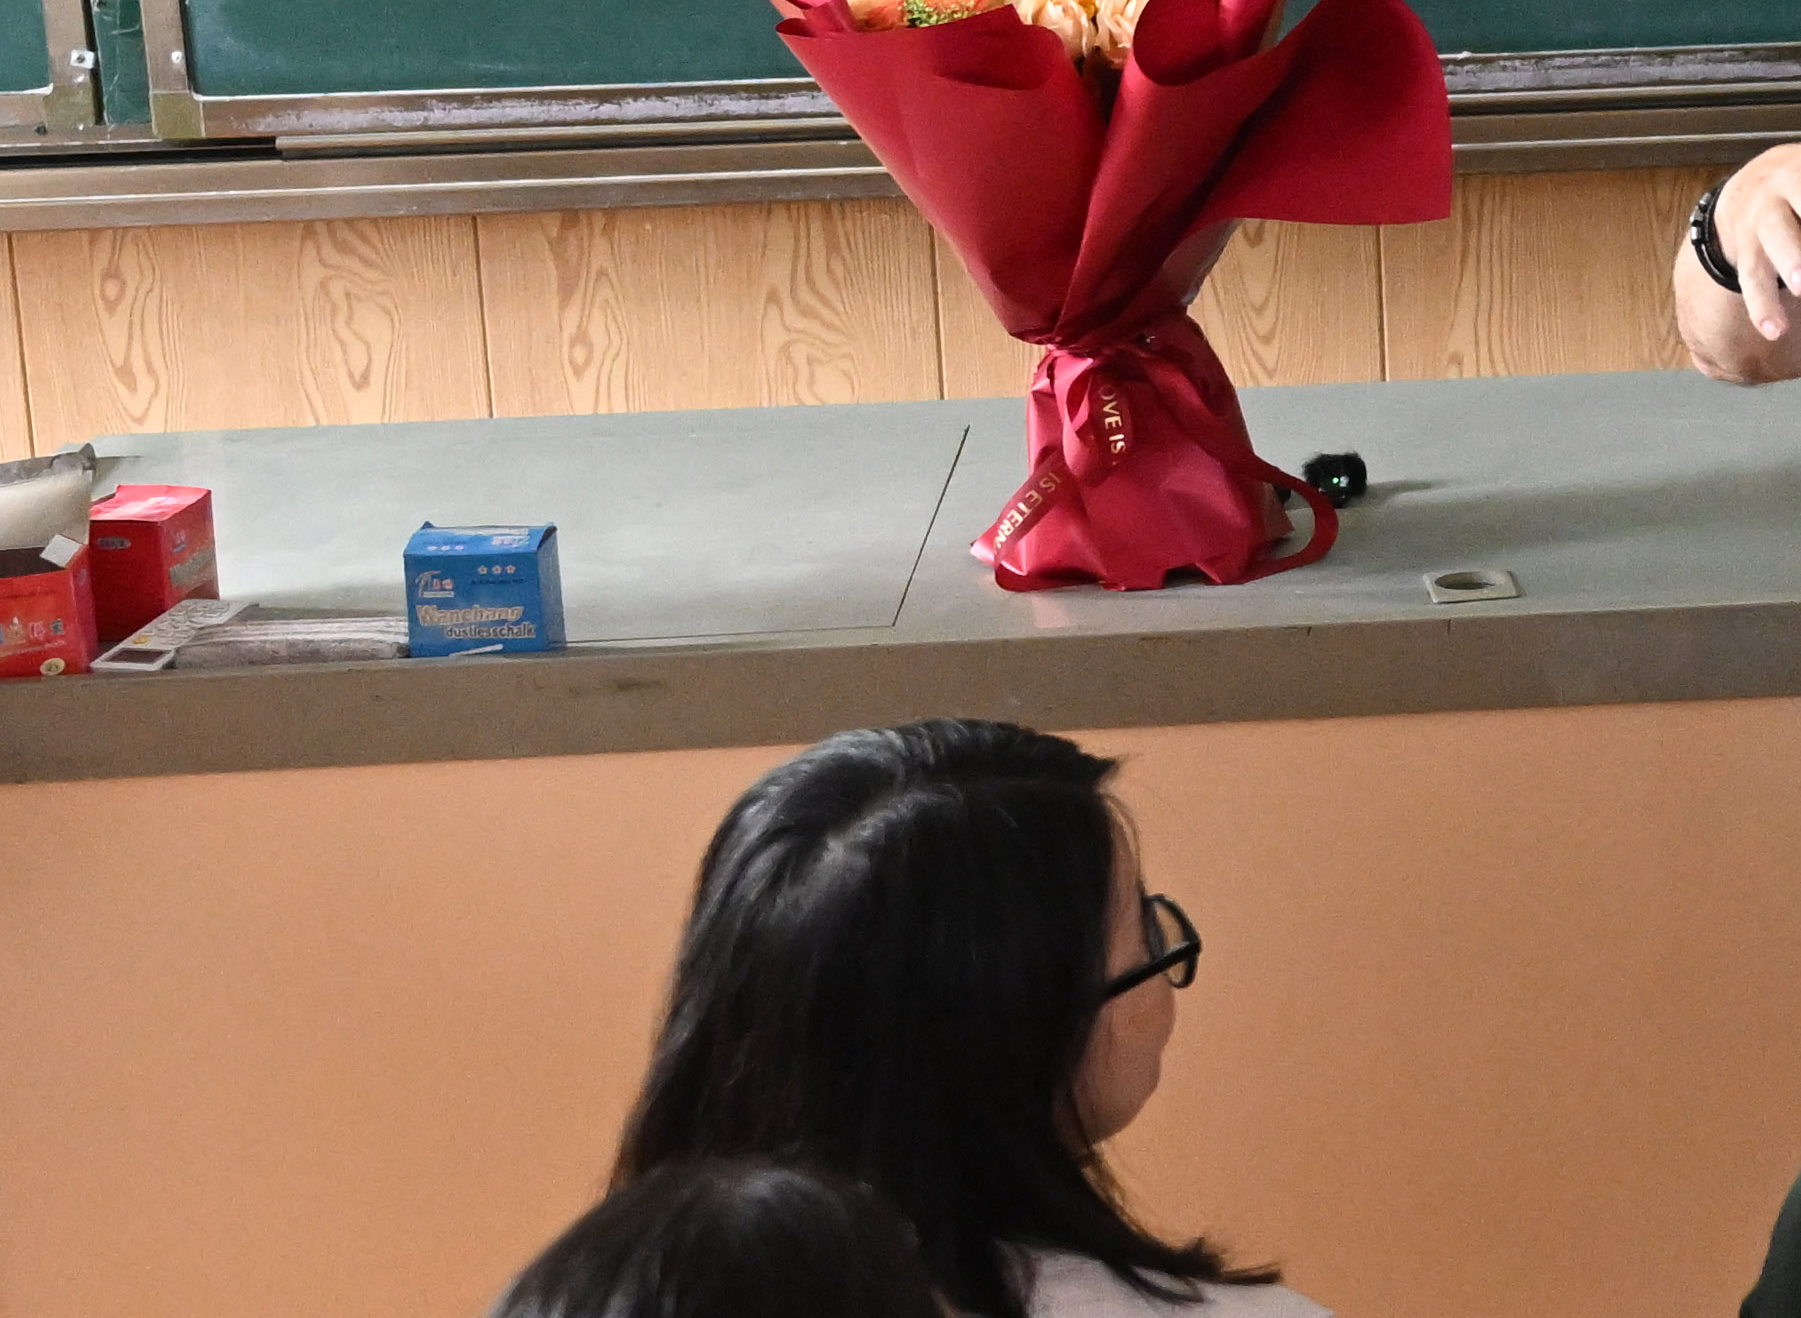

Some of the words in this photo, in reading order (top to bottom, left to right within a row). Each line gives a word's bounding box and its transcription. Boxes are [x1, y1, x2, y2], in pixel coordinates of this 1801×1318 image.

[1100, 385, 1122, 430] OVE
[1108, 434, 1126, 454] IS
[993, 489, 1043, 555] ETERN
